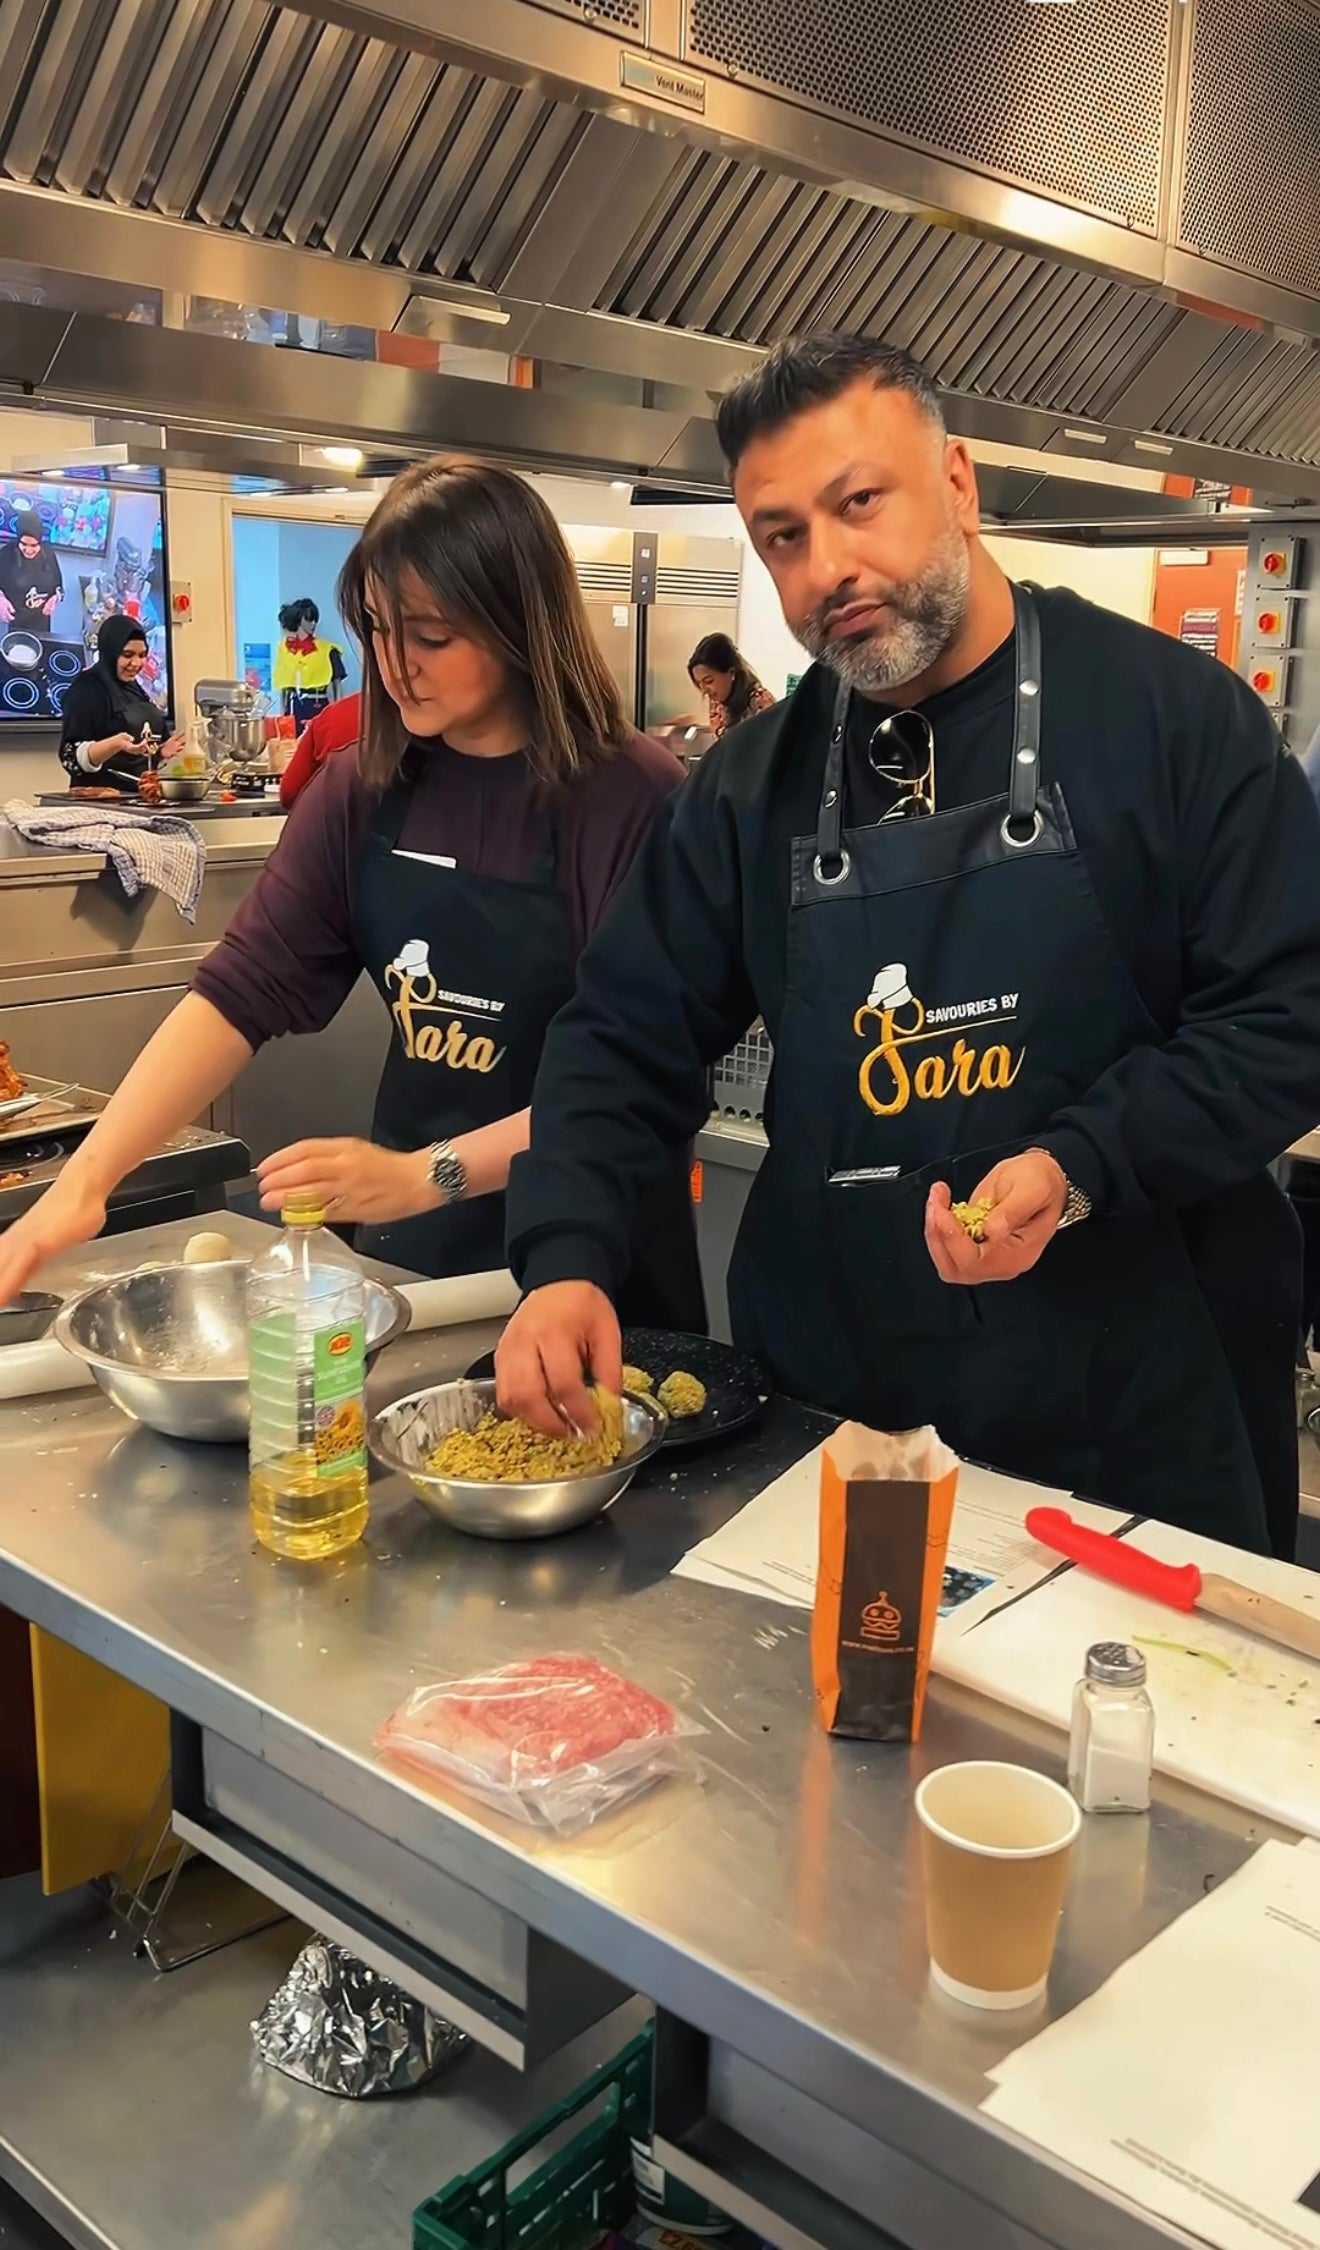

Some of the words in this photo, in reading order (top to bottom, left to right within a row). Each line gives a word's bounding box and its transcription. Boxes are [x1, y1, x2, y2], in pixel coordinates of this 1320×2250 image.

[925, 998, 998, 1024] SAVOURIES
[1000, 993, 1019, 1009] BY
[853, 997, 1026, 1115] Sara
